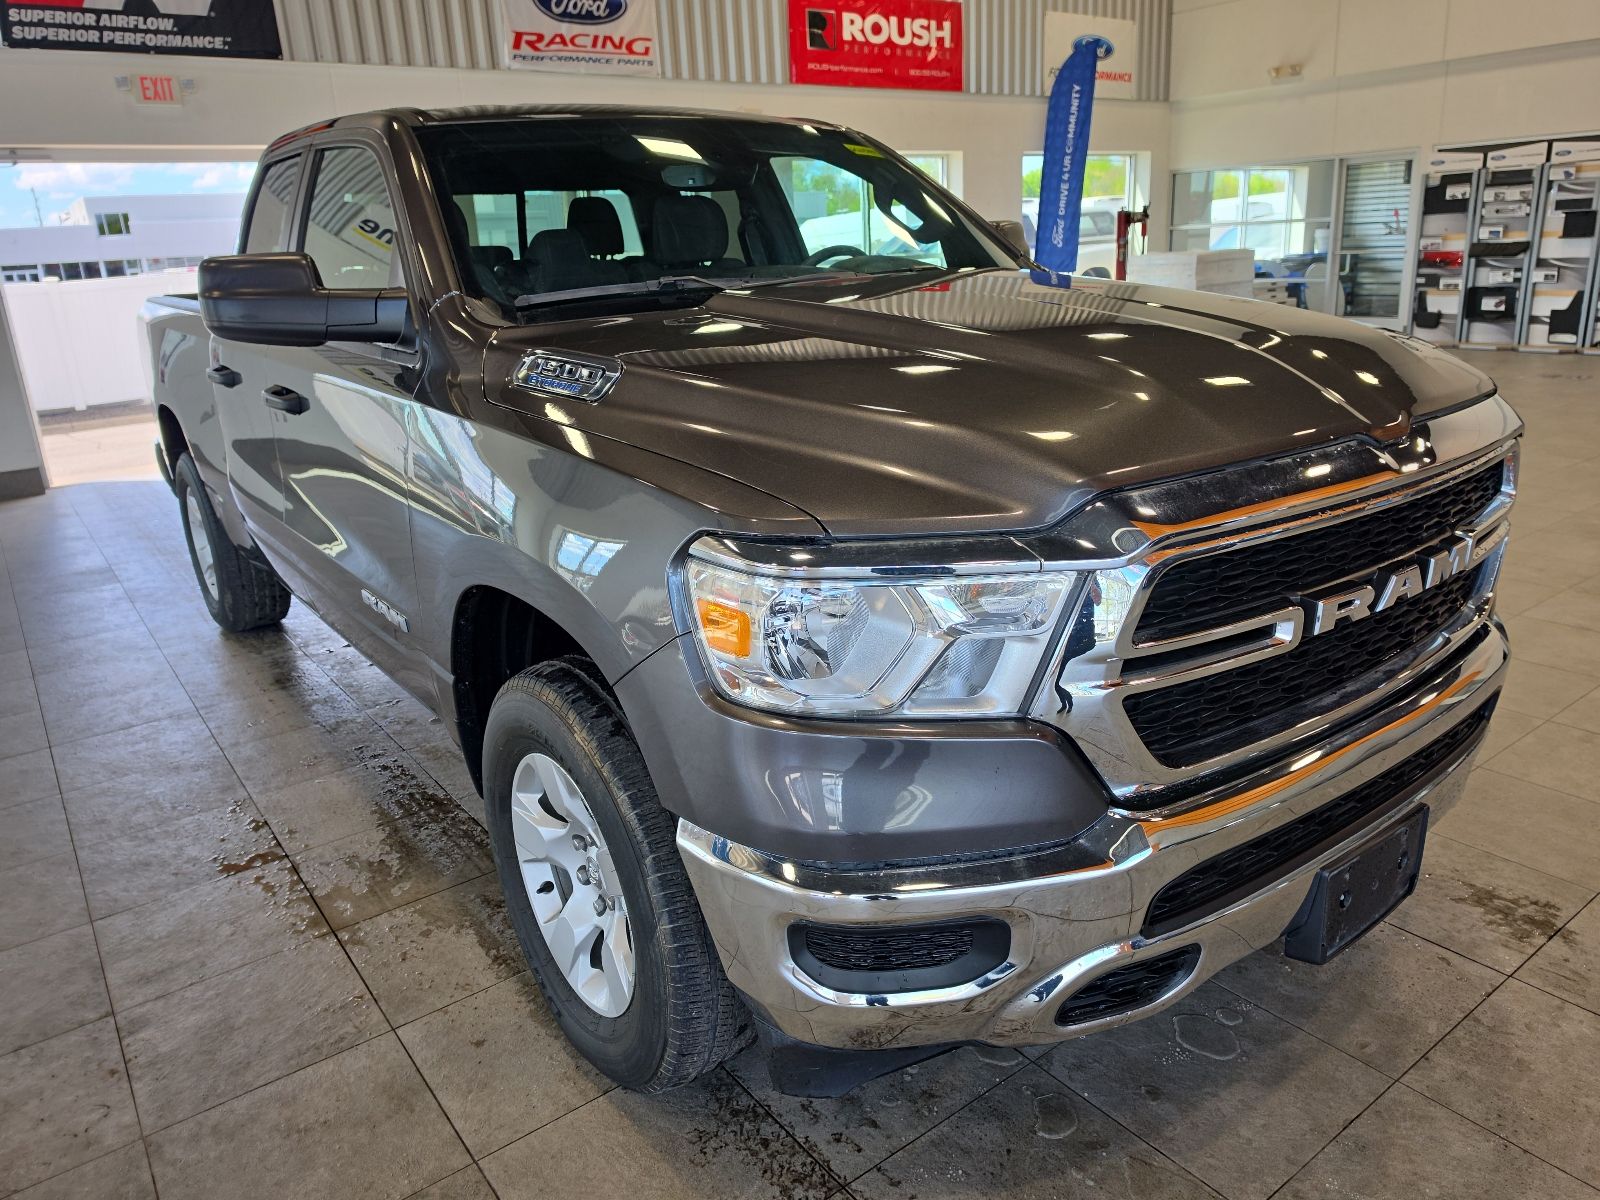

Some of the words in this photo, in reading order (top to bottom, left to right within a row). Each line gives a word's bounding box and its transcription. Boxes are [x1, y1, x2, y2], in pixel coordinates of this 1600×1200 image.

[8, 8, 97, 26] SUPERIOR
[99, 14, 178, 32] AIRFLOW.
[842, 12, 952, 48] ROUSH
[12, 26, 100, 43] SUPERIOR
[512, 30, 653, 56] RACING
[512, 53, 613, 65] PERFORMANCE
[617, 59, 654, 67] PARTS
[139, 75, 175, 101] EXIT
[1066, 84, 1081, 154] COMMUNITY
[1063, 156, 1072, 172] UR
[1059, 182, 1070, 216] DRIVE
[1052, 218, 1065, 248] Ford
[1313, 532, 1475, 636] RAM
